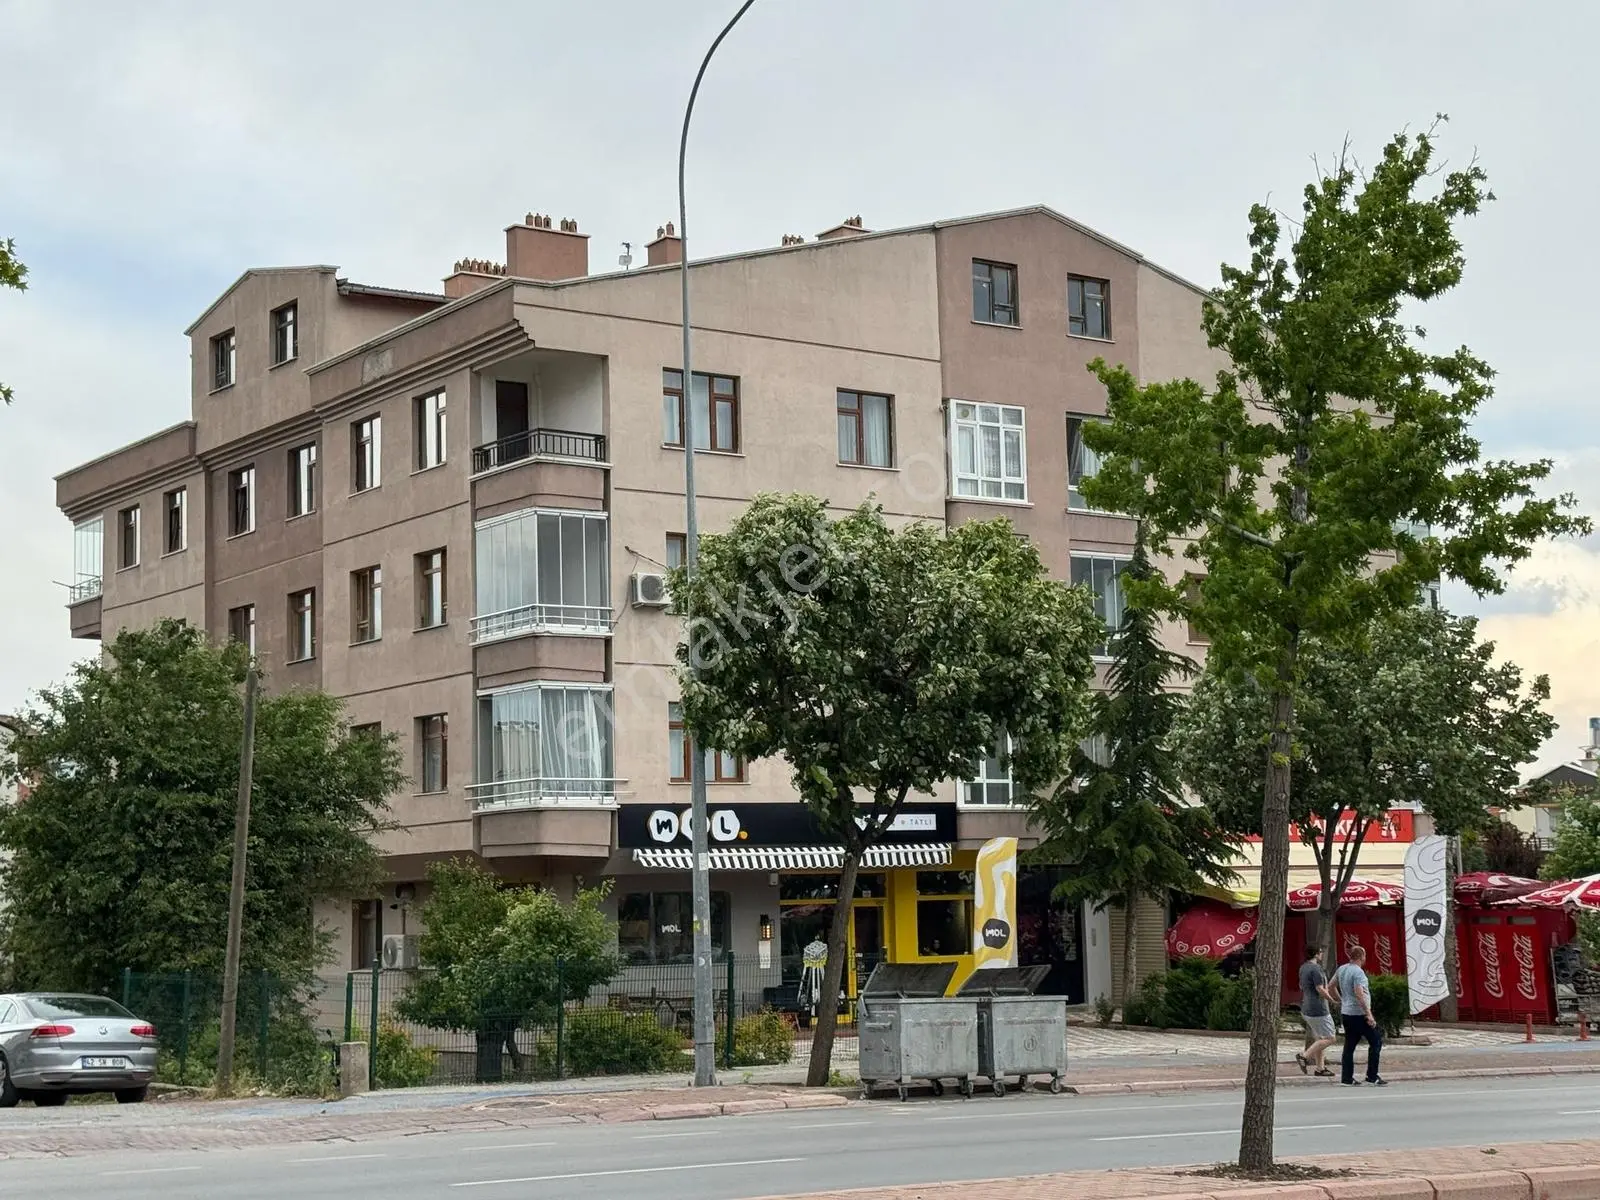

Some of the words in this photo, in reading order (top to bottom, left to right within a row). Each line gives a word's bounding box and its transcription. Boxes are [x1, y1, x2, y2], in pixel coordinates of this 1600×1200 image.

[1416, 918, 1439, 926] MOL
[661, 924, 682, 934] MOL
[985, 928, 1007, 938] MOL
